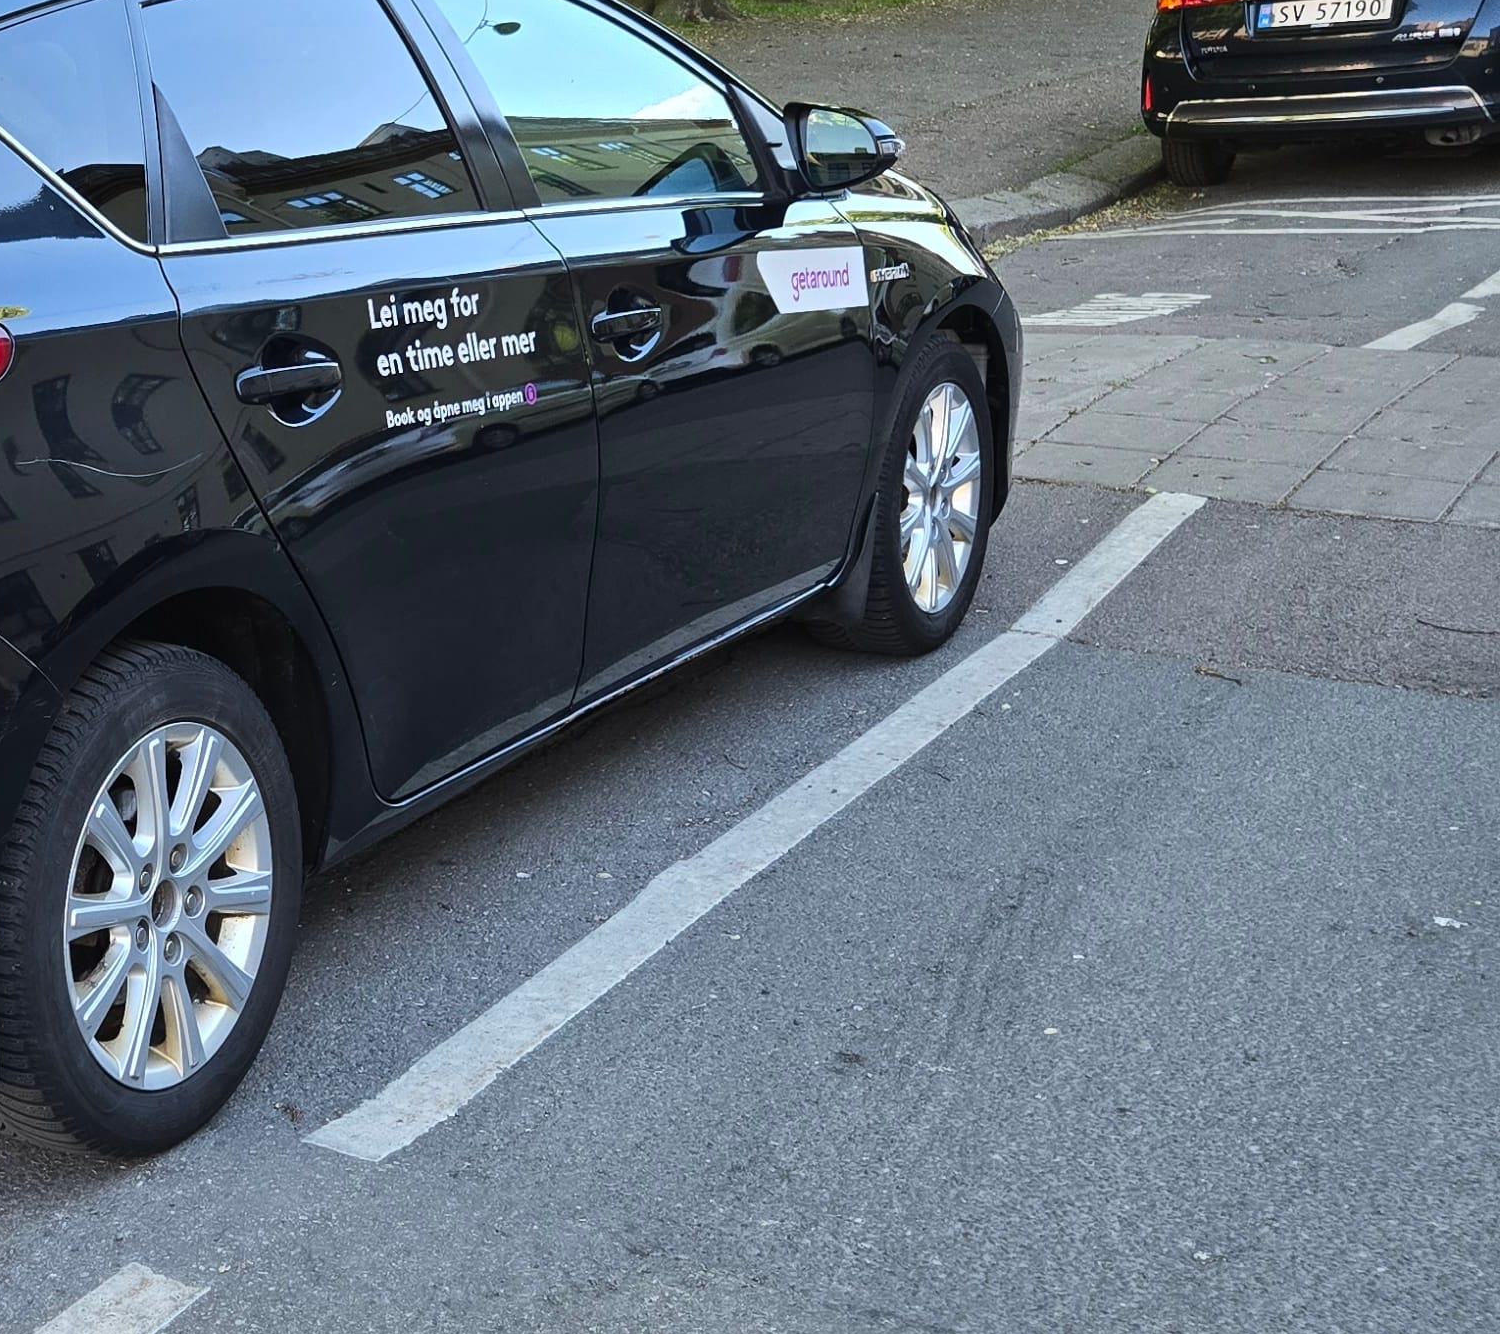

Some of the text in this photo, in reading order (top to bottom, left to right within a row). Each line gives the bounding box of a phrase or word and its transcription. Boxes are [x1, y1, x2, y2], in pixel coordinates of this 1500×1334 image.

[1279, 4, 1305, 24] SV
[791, 262, 850, 301] getaround
[367, 287, 480, 330] Lei meg for
[376, 330, 536, 377] en time eller mer
[385, 406, 416, 429] Book
[417, 408, 432, 426] og
[433, 401, 461, 423] åpne
[461, 398, 486, 416] meg
[486, 391, 491, 409] i
[492, 389, 524, 412] appen
